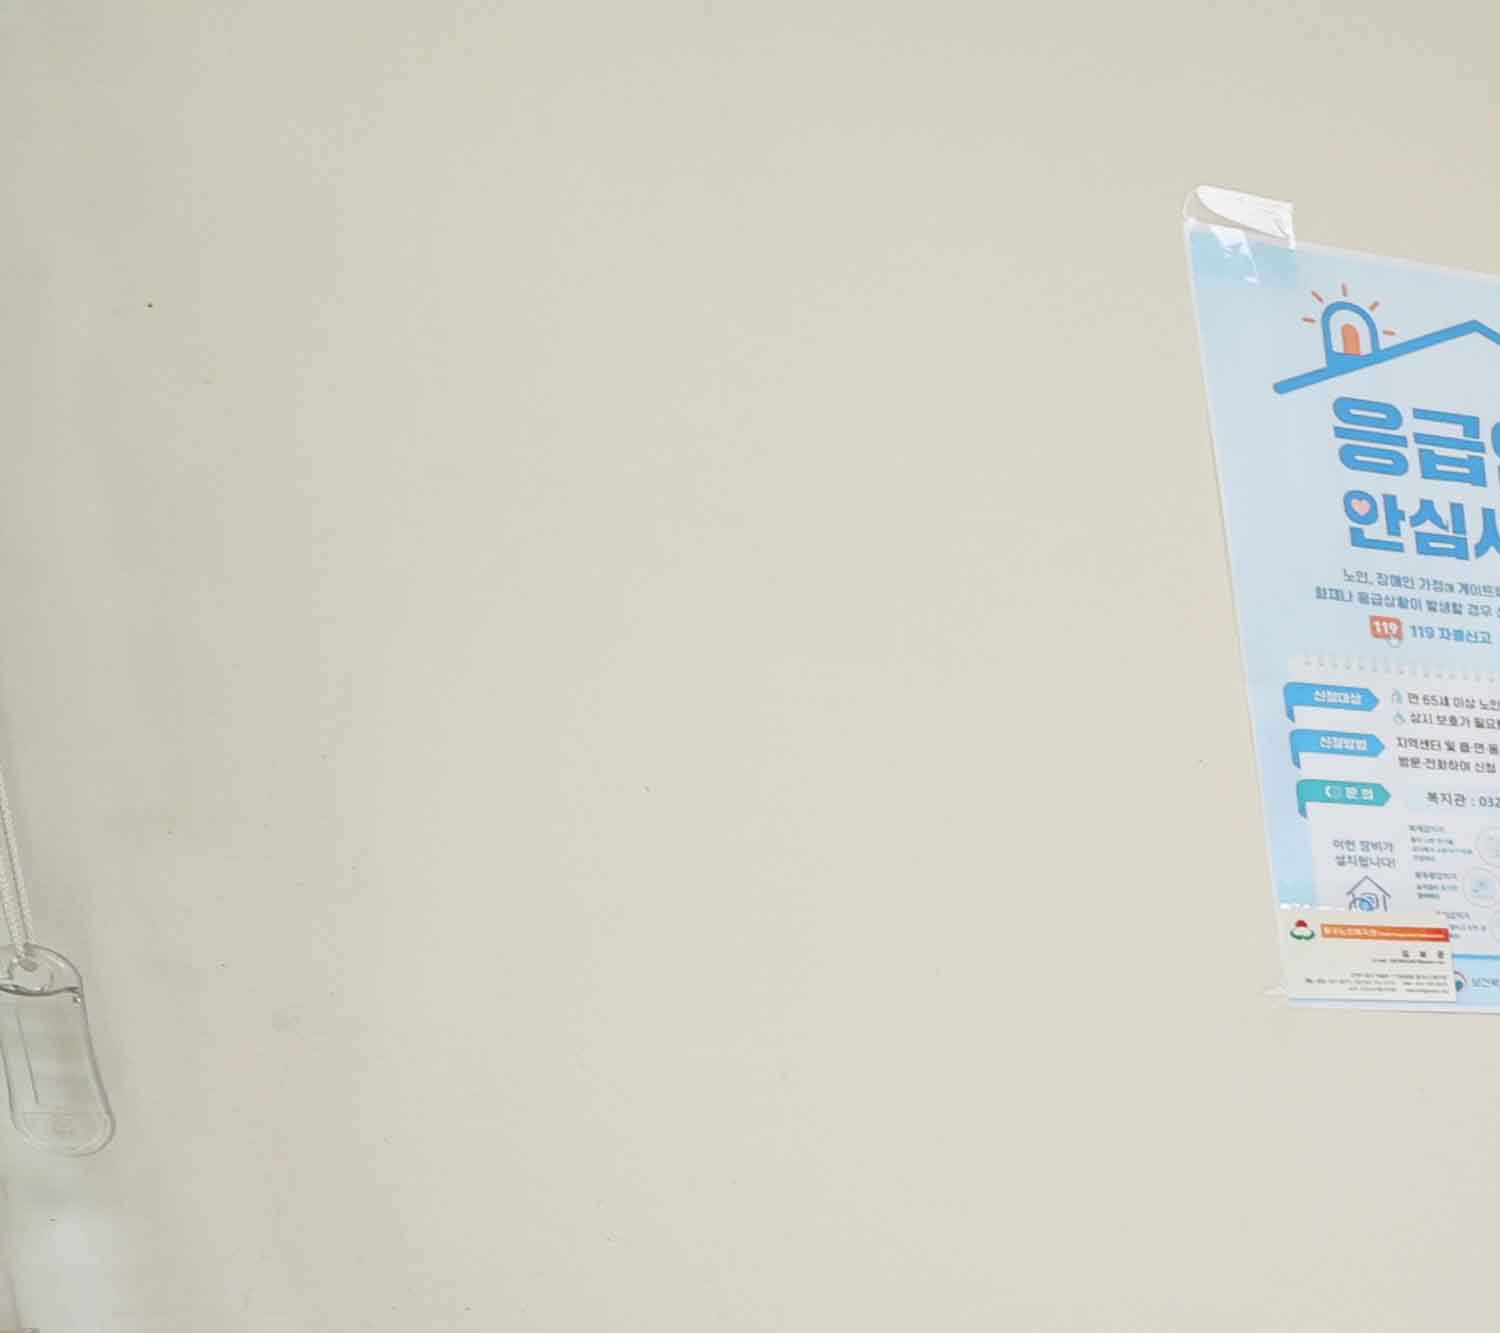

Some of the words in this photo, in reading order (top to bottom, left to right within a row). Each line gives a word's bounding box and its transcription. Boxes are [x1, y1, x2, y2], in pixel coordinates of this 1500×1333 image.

[1376, 572, 1416, 590] 장애인
[1373, 621, 1399, 636] 119
[1410, 624, 1435, 640] 119
[1438, 626, 1492, 645] 자동신고
[1408, 692, 1420, 705] 만
[1423, 694, 1451, 708] 65세
[1453, 695, 1476, 710] 이상
[1479, 697, 1500, 712] 노인
[1410, 712, 1433, 725] 상시
[1436, 714, 1471, 729] 보호가
[1396, 737, 1441, 751] 지역센터
[1444, 740, 1456, 753] 및
[1474, 760, 1497, 774] 신청
[1426, 791, 1467, 808] 복지관
[1332, 839, 1356, 851] 이런
[1359, 840, 1393, 852] 장비가
